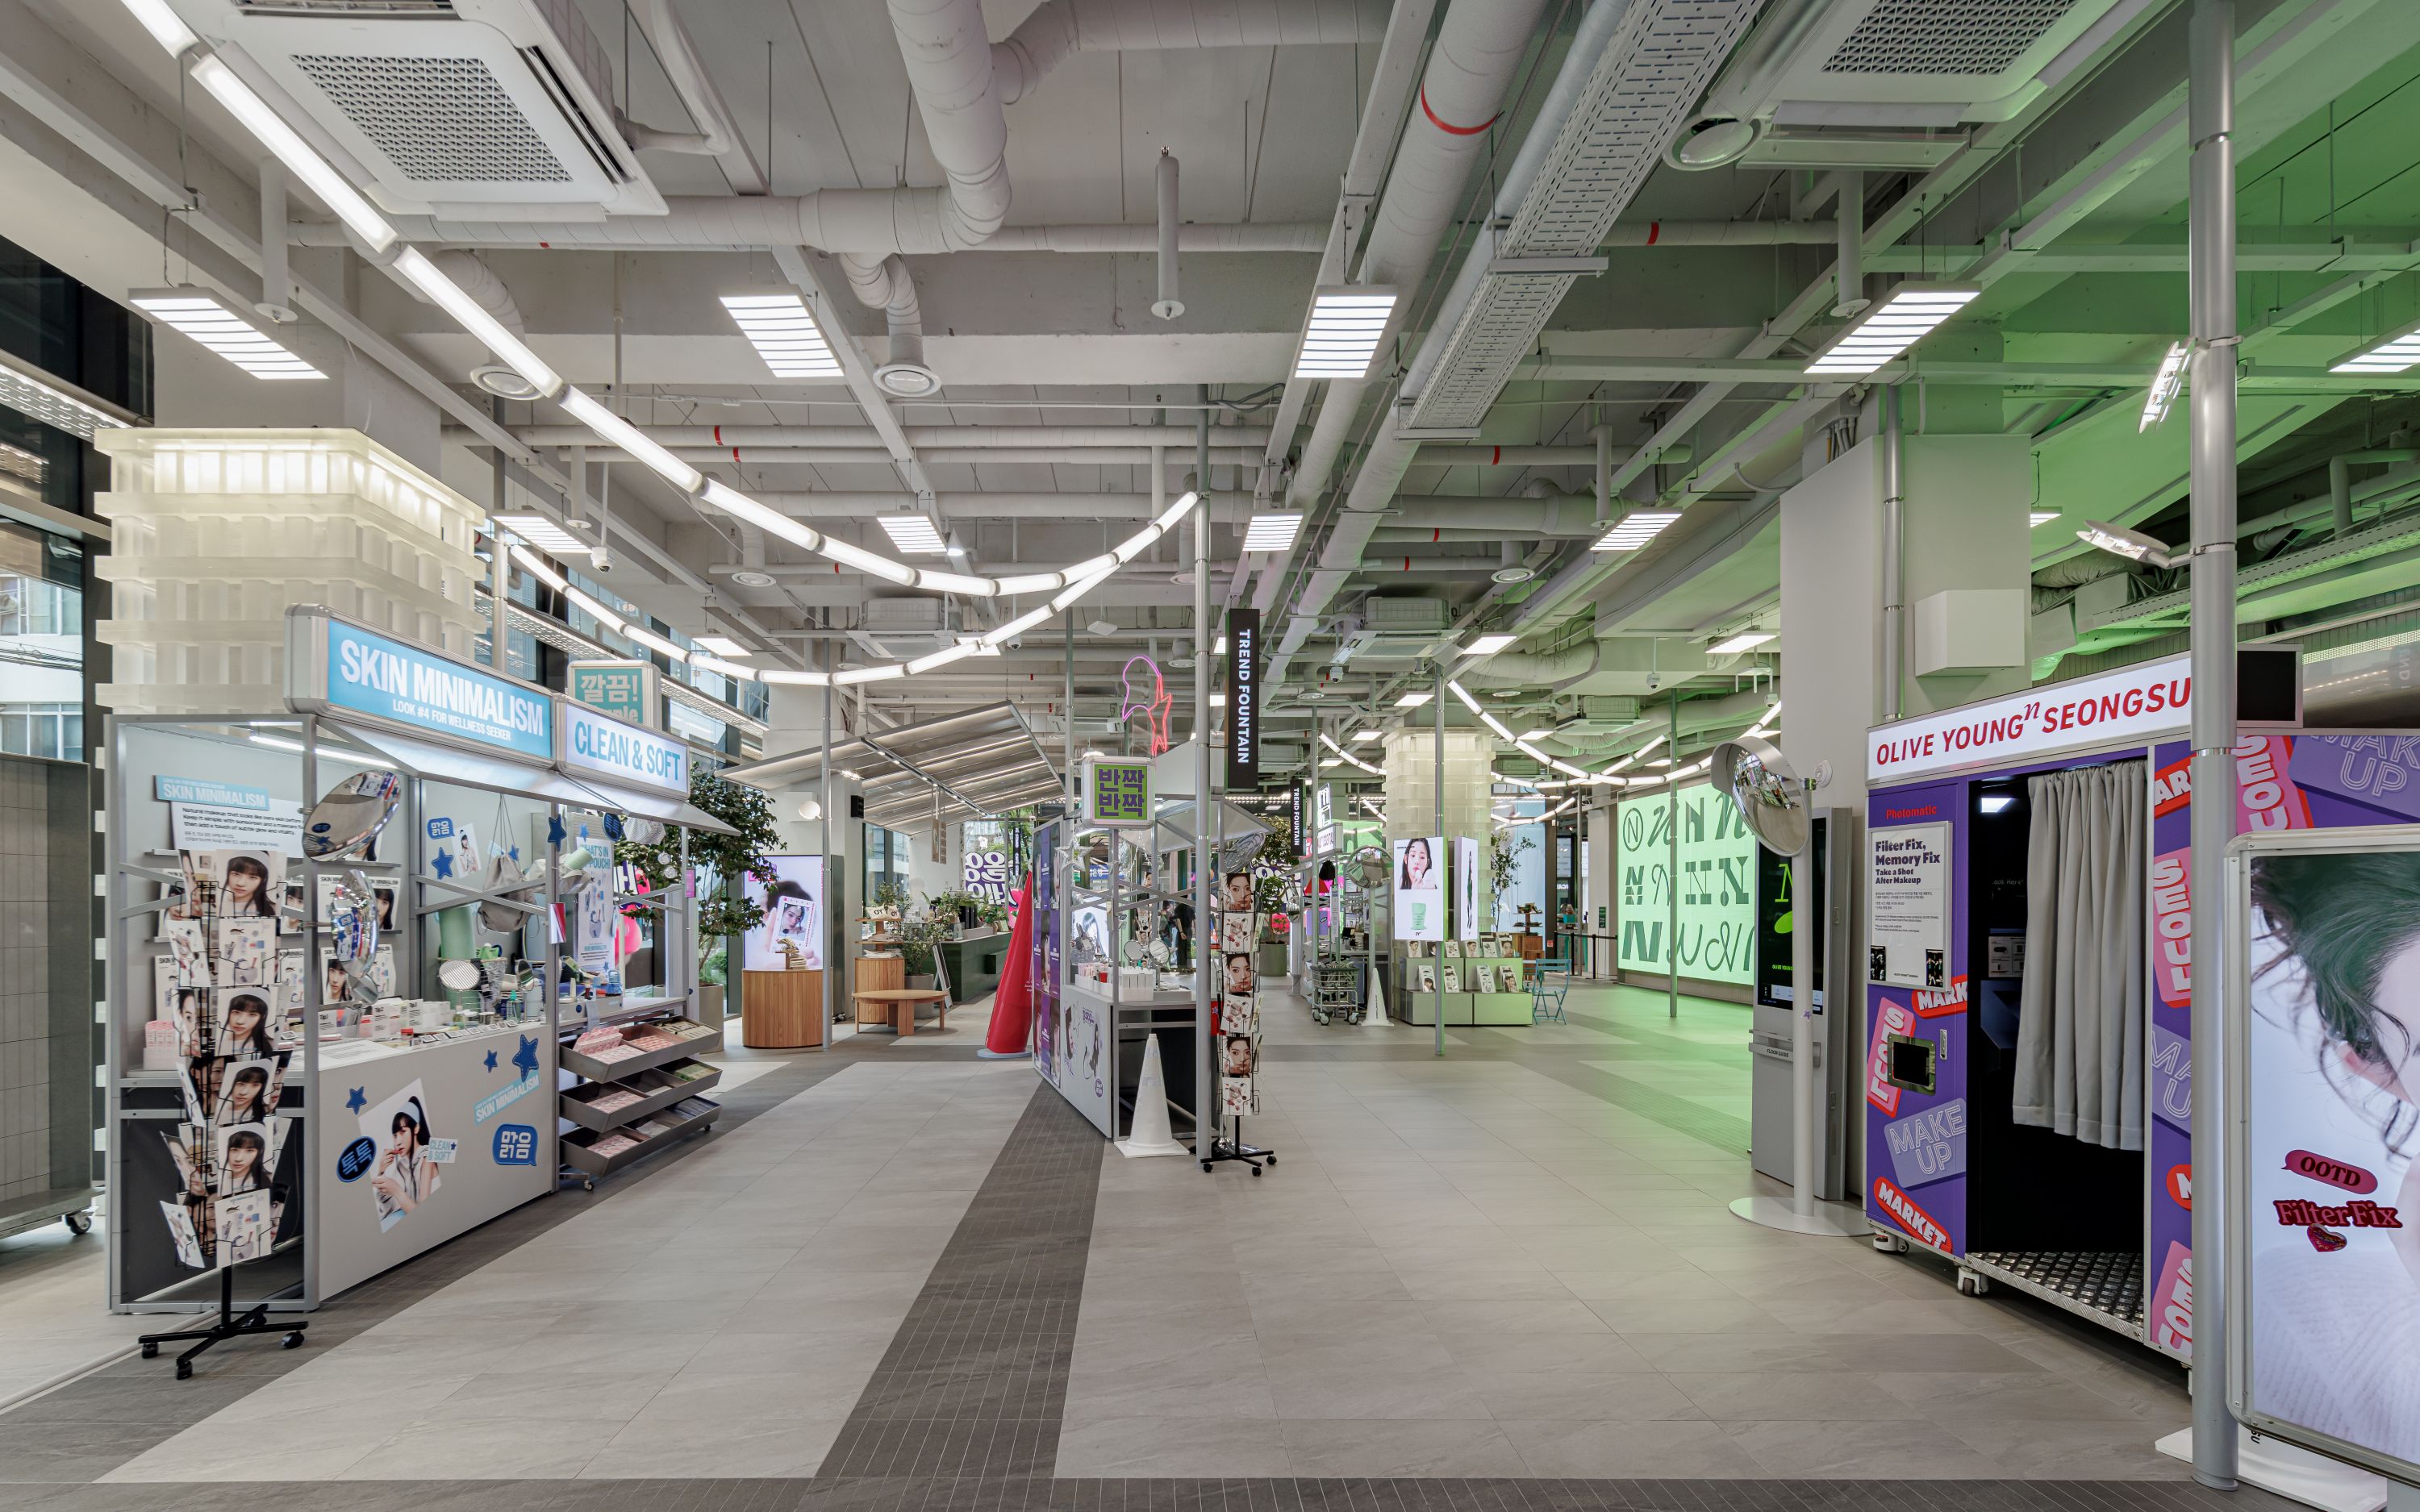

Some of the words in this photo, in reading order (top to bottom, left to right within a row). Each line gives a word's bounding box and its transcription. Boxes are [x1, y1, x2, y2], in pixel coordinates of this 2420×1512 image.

[1238, 629, 1250, 681] TREND
[340, 639, 407, 698] SKIN
[413, 663, 544, 737] MINIMALISM
[580, 674, 638, 702] 깔끔!
[393, 699, 416, 714] LOOK
[418, 705, 430, 719] #4
[432, 709, 448, 725] FOR
[448, 713, 486, 735] WELLNESS
[486, 724, 511, 741] SEEKER
[1237, 685, 1250, 764] FOUNTAIN
[1876, 733, 1934, 765] OLIVE
[1942, 714, 2024, 752] YOUNG
[2042, 677, 2191, 733] SEONGSU
[574, 721, 628, 767] CLEAN
[632, 739, 643, 771] &
[646, 744, 681, 781] SOFT
[2311, 735, 2420, 769] AK
[1099, 768, 1145, 793] 반짝
[2154, 764, 2191, 806] AR
[2340, 751, 2407, 797] UP
[164, 783, 194, 800] SKIN
[195, 786, 265, 807] MINIMALISM
[1099, 793, 1145, 817] 반짝
[431, 820, 450, 835] 맑음
[1685, 797, 1704, 843] N
[1885, 805, 1937, 820] Photomatic
[1876, 839, 1904, 852] Filter
[1905, 838, 1926, 852] Fix,
[1876, 855, 1921, 867] Memory
[1922, 851, 1941, 864] Fix
[1893, 877, 1921, 885] Makeup
[1917, 981, 1967, 1010] MARK
[476, 1102, 495, 1123] SKIN
[495, 1074, 540, 1111] MINIMALISM
[429, 1139, 451, 1151] CLEAN
[499, 1131, 532, 1159] 맑음
[1889, 1104, 1967, 1155] MAKE
[434, 1150, 452, 1161] SOFT
[1916, 1142, 1952, 1175] UP
[2300, 1156, 2360, 1187] OOTD
[1878, 1182, 1946, 1249] MARKET
[2276, 1202, 2348, 1225] Filter
[2350, 1202, 2397, 1227] Fix
